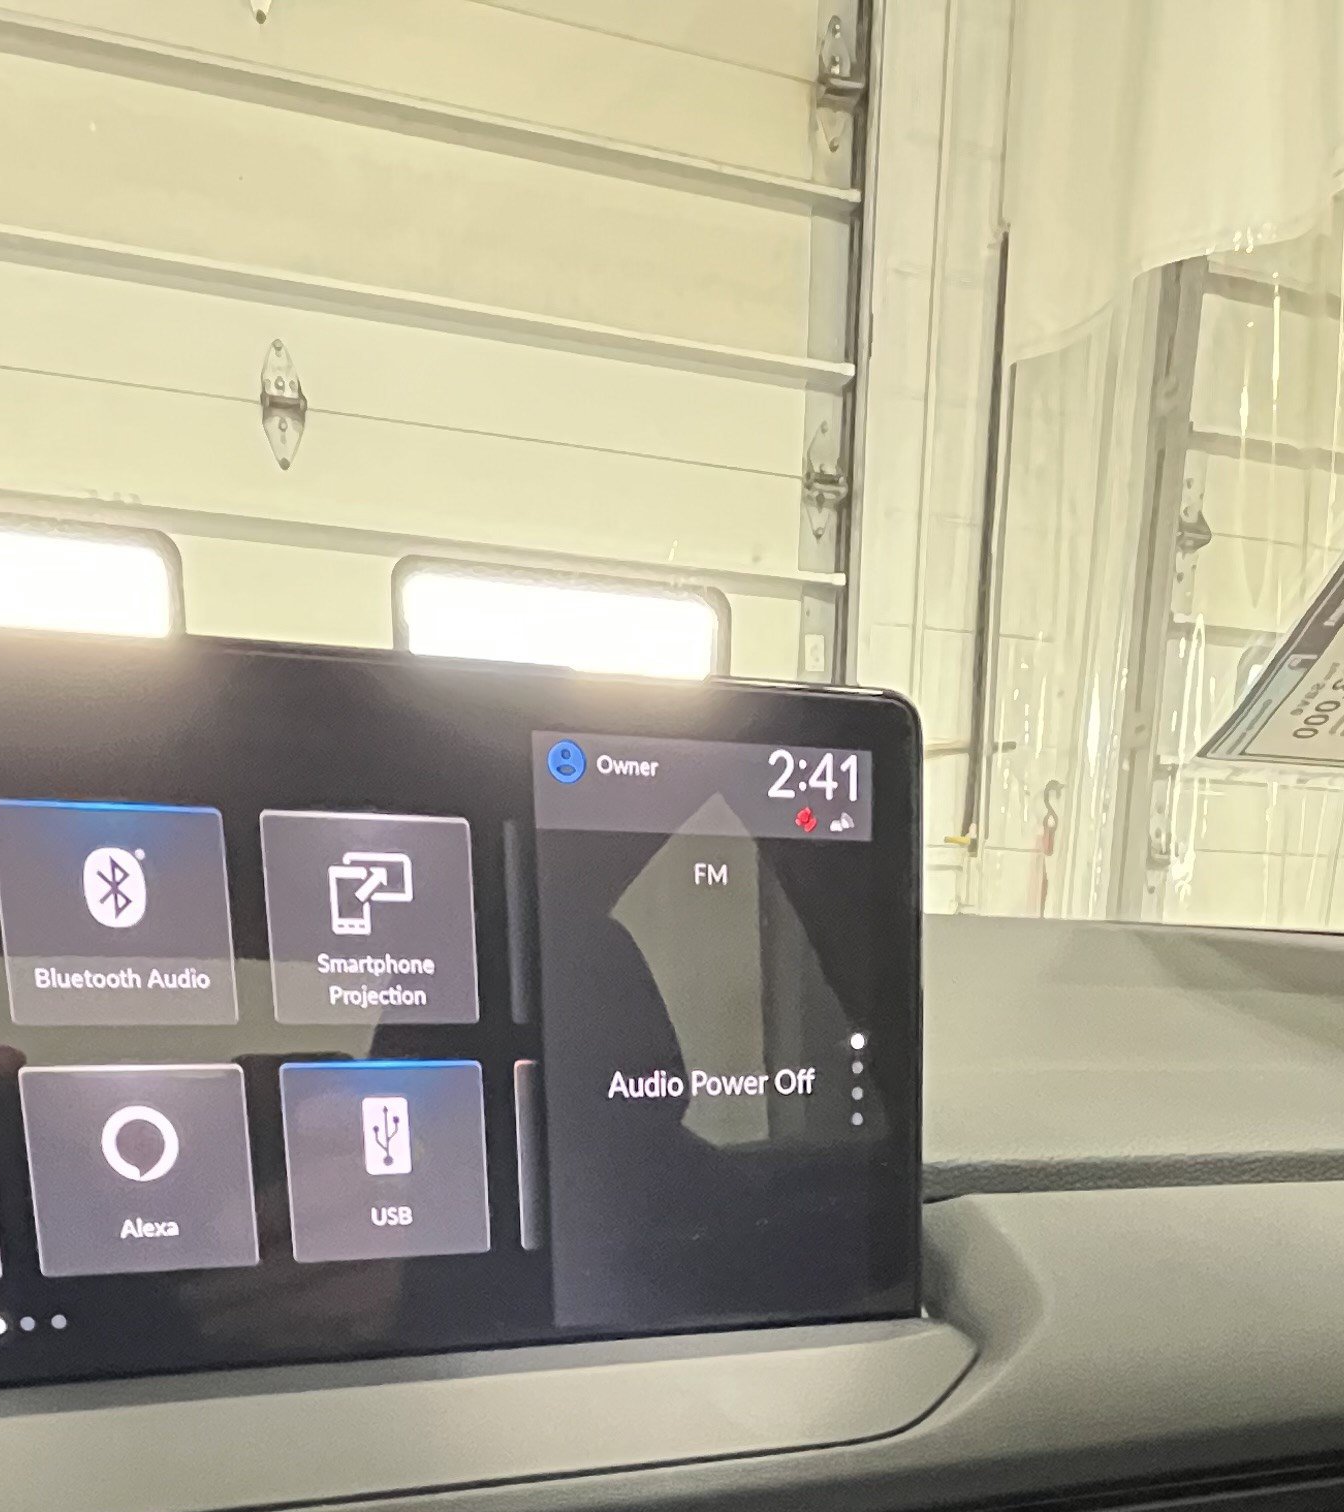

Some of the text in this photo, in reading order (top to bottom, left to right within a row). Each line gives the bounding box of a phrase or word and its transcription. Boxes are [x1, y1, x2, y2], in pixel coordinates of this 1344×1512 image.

[596, 754, 659, 777] Owner
[767, 748, 858, 802] 2:41
[694, 862, 728, 886] FM
[317, 952, 435, 977] Smartphone
[34, 967, 211, 989] Bluetooth Audio
[328, 984, 427, 1009] Projection
[607, 1067, 816, 1099] Audio Power Off
[120, 1217, 180, 1239] Alexa
[370, 1206, 413, 1227] USB
